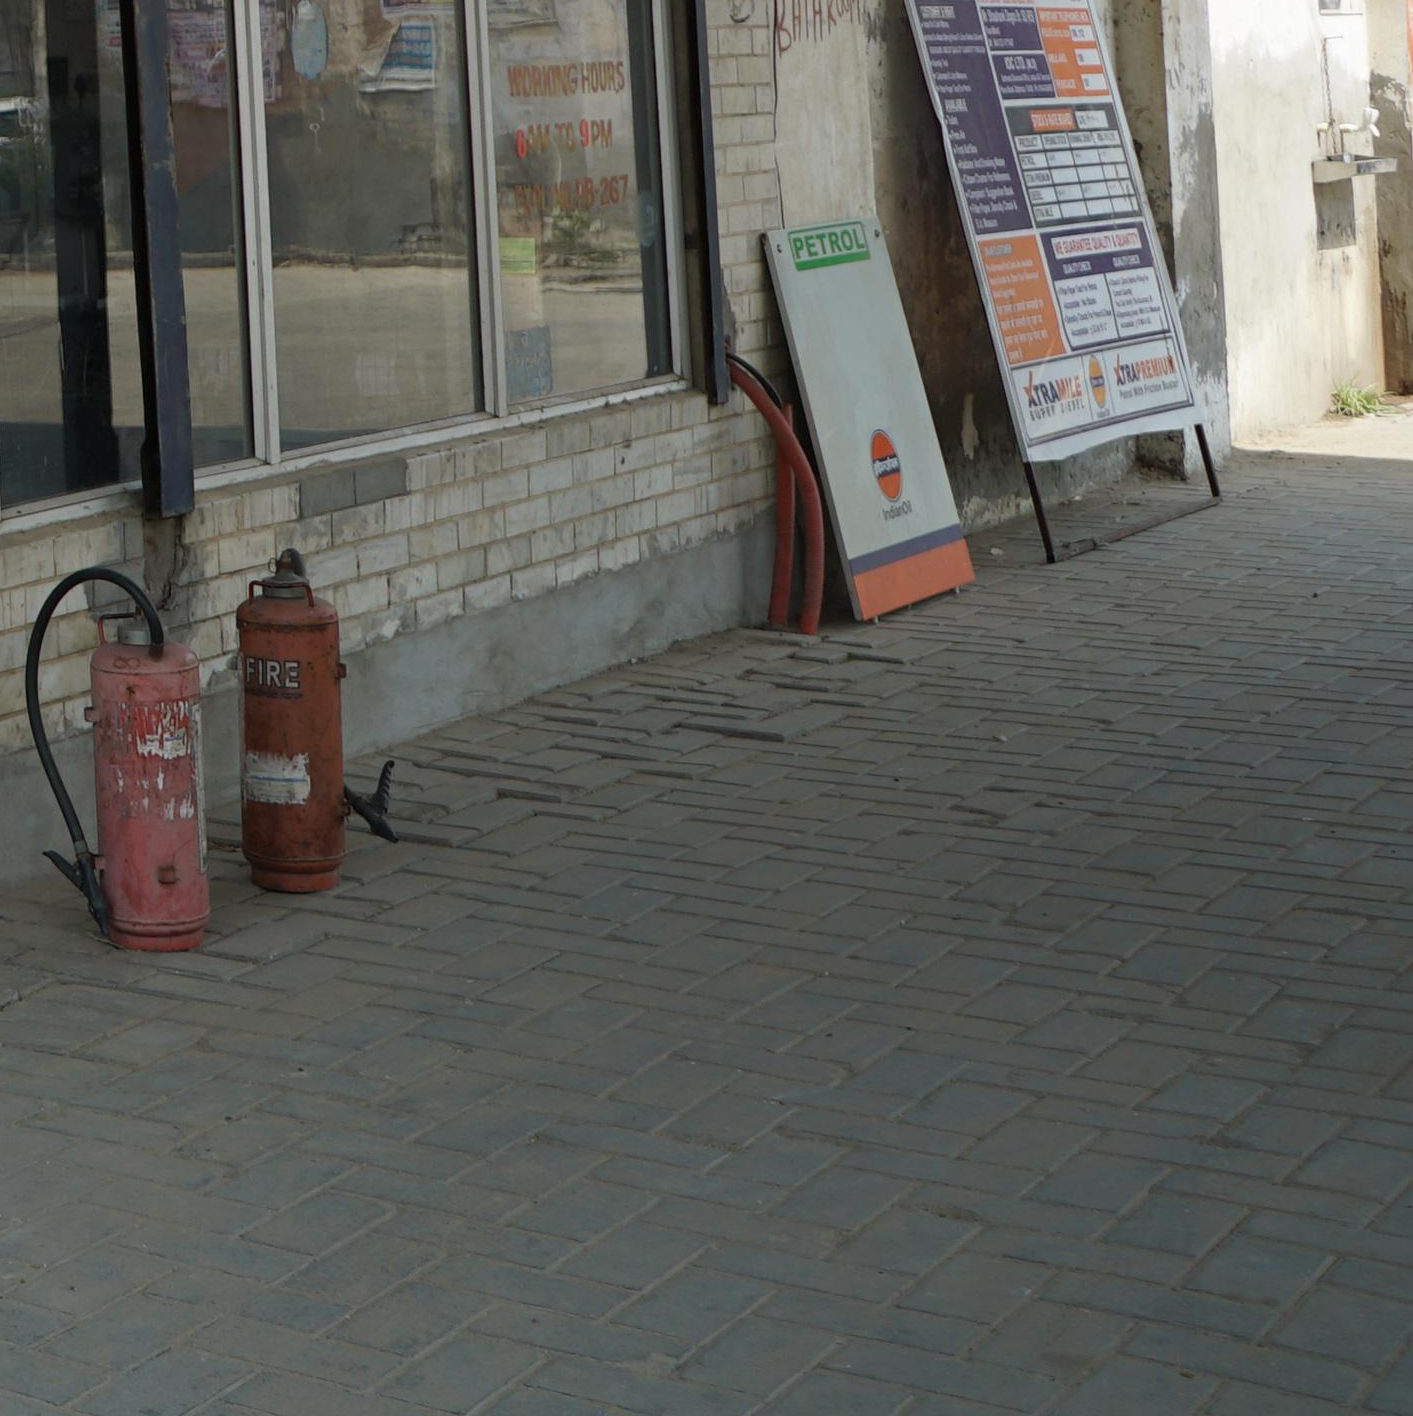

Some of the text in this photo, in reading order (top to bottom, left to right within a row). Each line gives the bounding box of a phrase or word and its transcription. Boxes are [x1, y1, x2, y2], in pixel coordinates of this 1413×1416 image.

[507, 60, 625, 97] WORKING HOURS
[792, 228, 866, 260] PETROL
[1113, 353, 1177, 386] XTRAPREMIUM
[1023, 371, 1083, 408] XTRAMILE
[882, 500, 913, 521] IndianOil
[245, 659, 301, 689] FIRE
